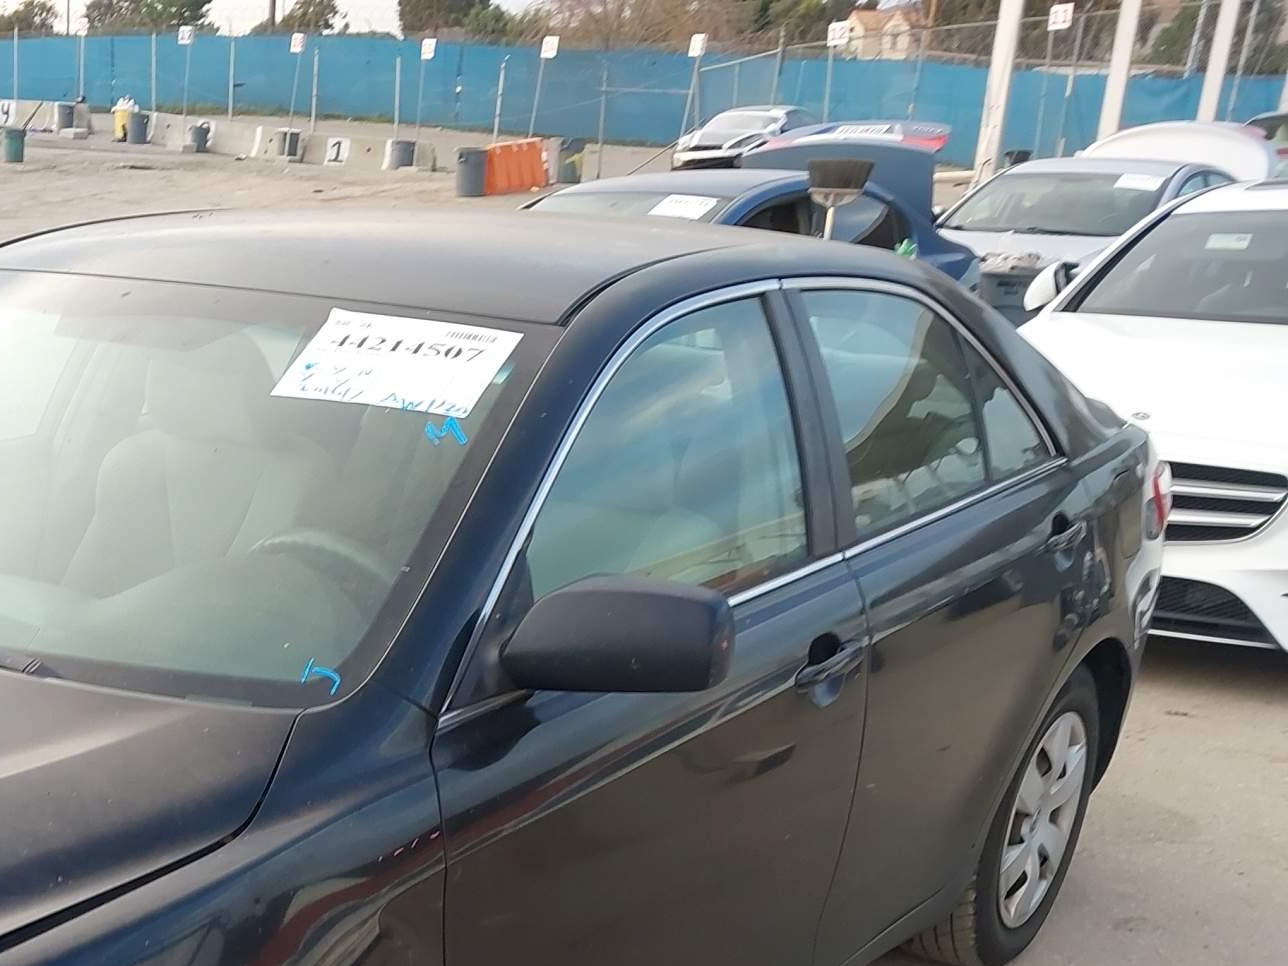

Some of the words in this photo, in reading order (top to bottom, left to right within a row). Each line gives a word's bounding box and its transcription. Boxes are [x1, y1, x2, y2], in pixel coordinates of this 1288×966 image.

[1, 102, 11, 124] 4
[327, 140, 343, 163] 1
[330, 333, 487, 362] 44214507
